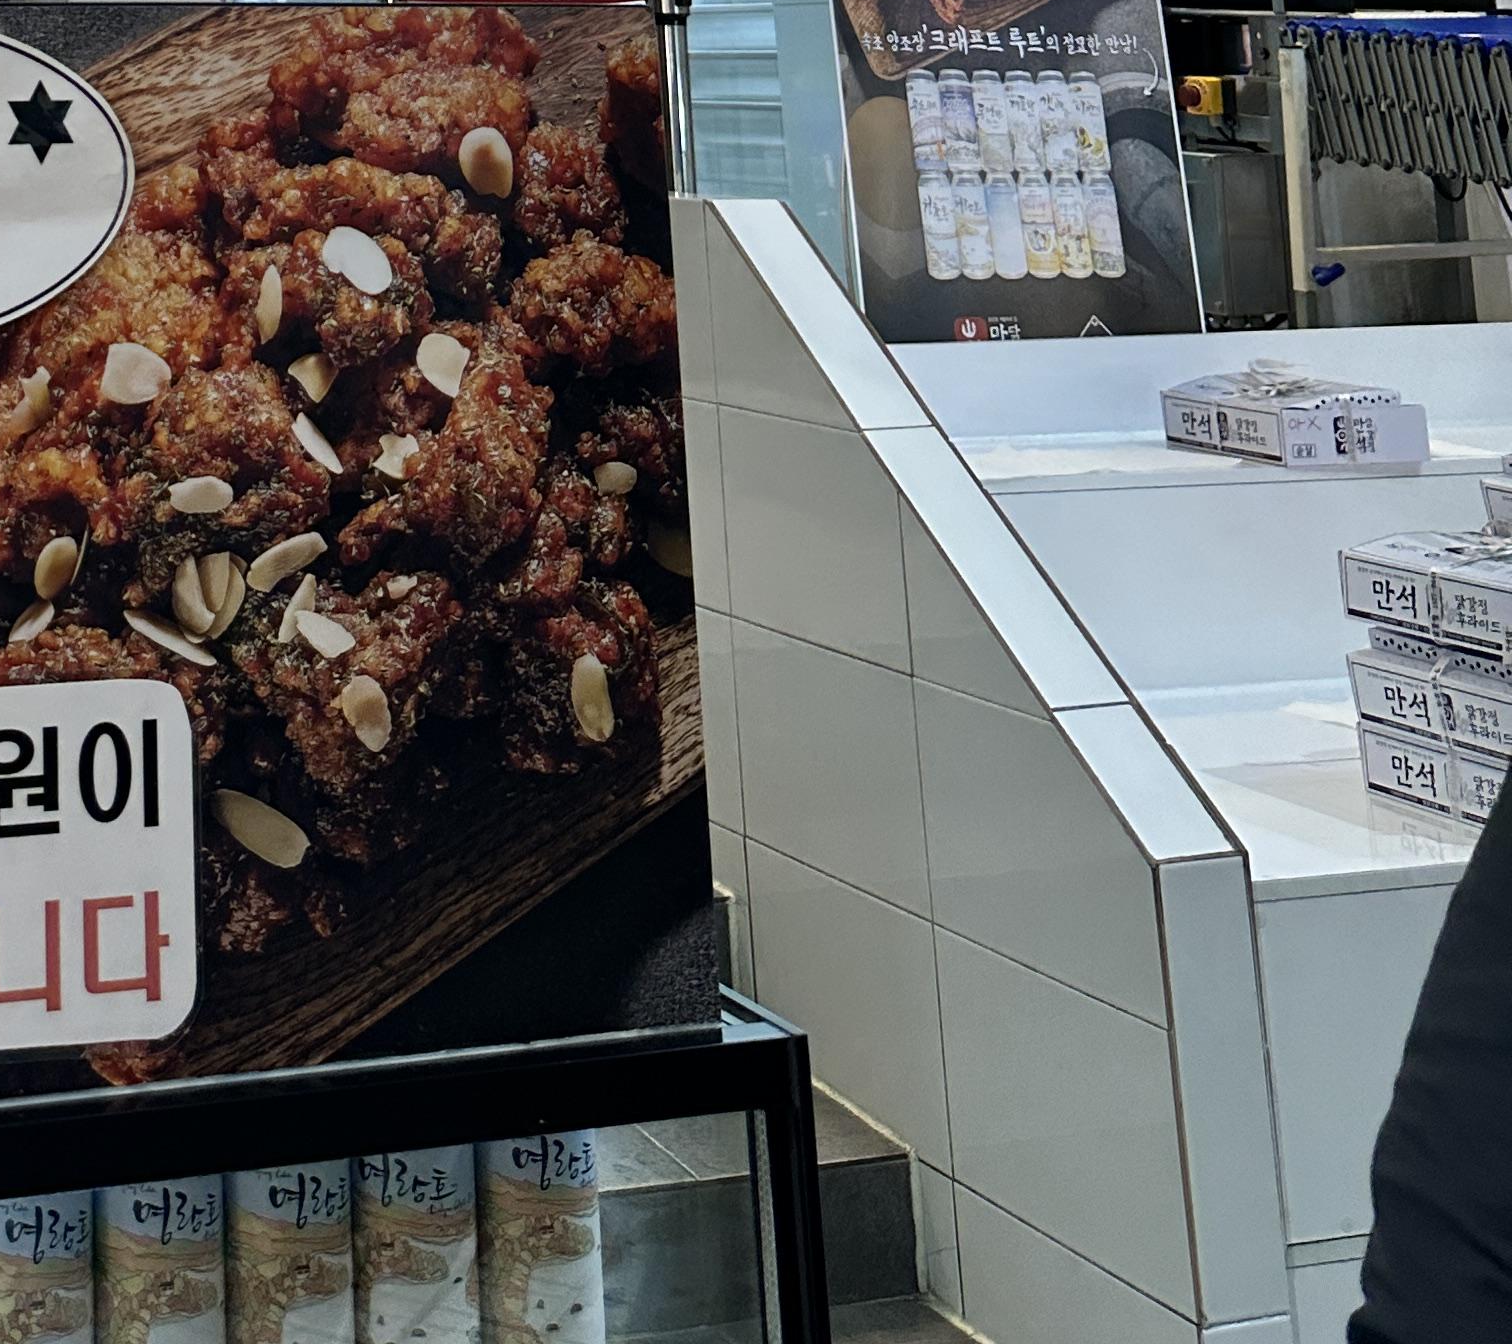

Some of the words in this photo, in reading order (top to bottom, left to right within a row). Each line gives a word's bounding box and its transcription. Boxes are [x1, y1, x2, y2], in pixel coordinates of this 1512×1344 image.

[1181, 410, 1213, 441] 만석
[1372, 579, 1418, 619] 만석
[1455, 611, 1502, 634] 후라이드
[1384, 685, 1432, 728] 만석
[1391, 755, 1438, 798] 만석
